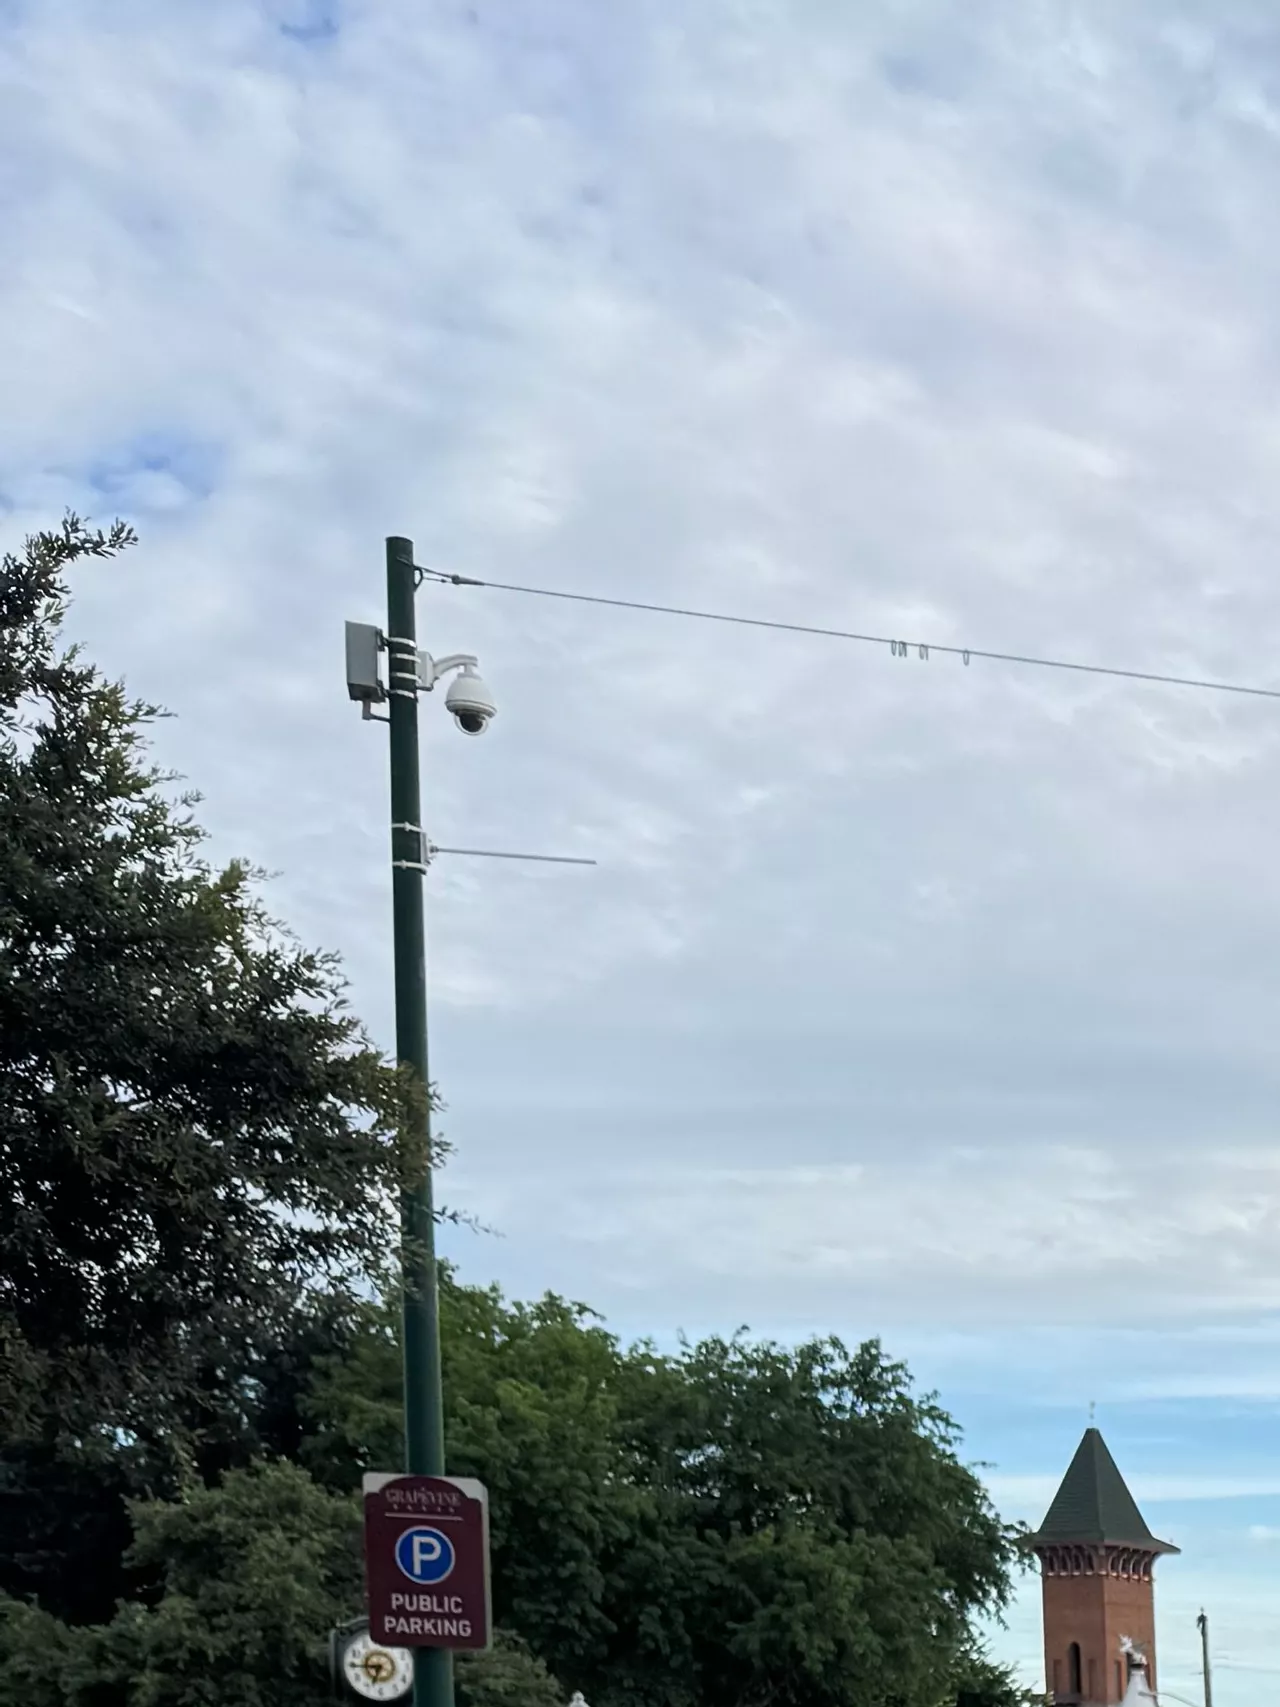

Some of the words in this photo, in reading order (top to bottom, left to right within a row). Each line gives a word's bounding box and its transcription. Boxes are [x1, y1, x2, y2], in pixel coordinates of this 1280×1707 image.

[412, 1535, 442, 1576] P
[391, 1593, 463, 1614] PUBLIC
[384, 1615, 472, 1637] PARKING
